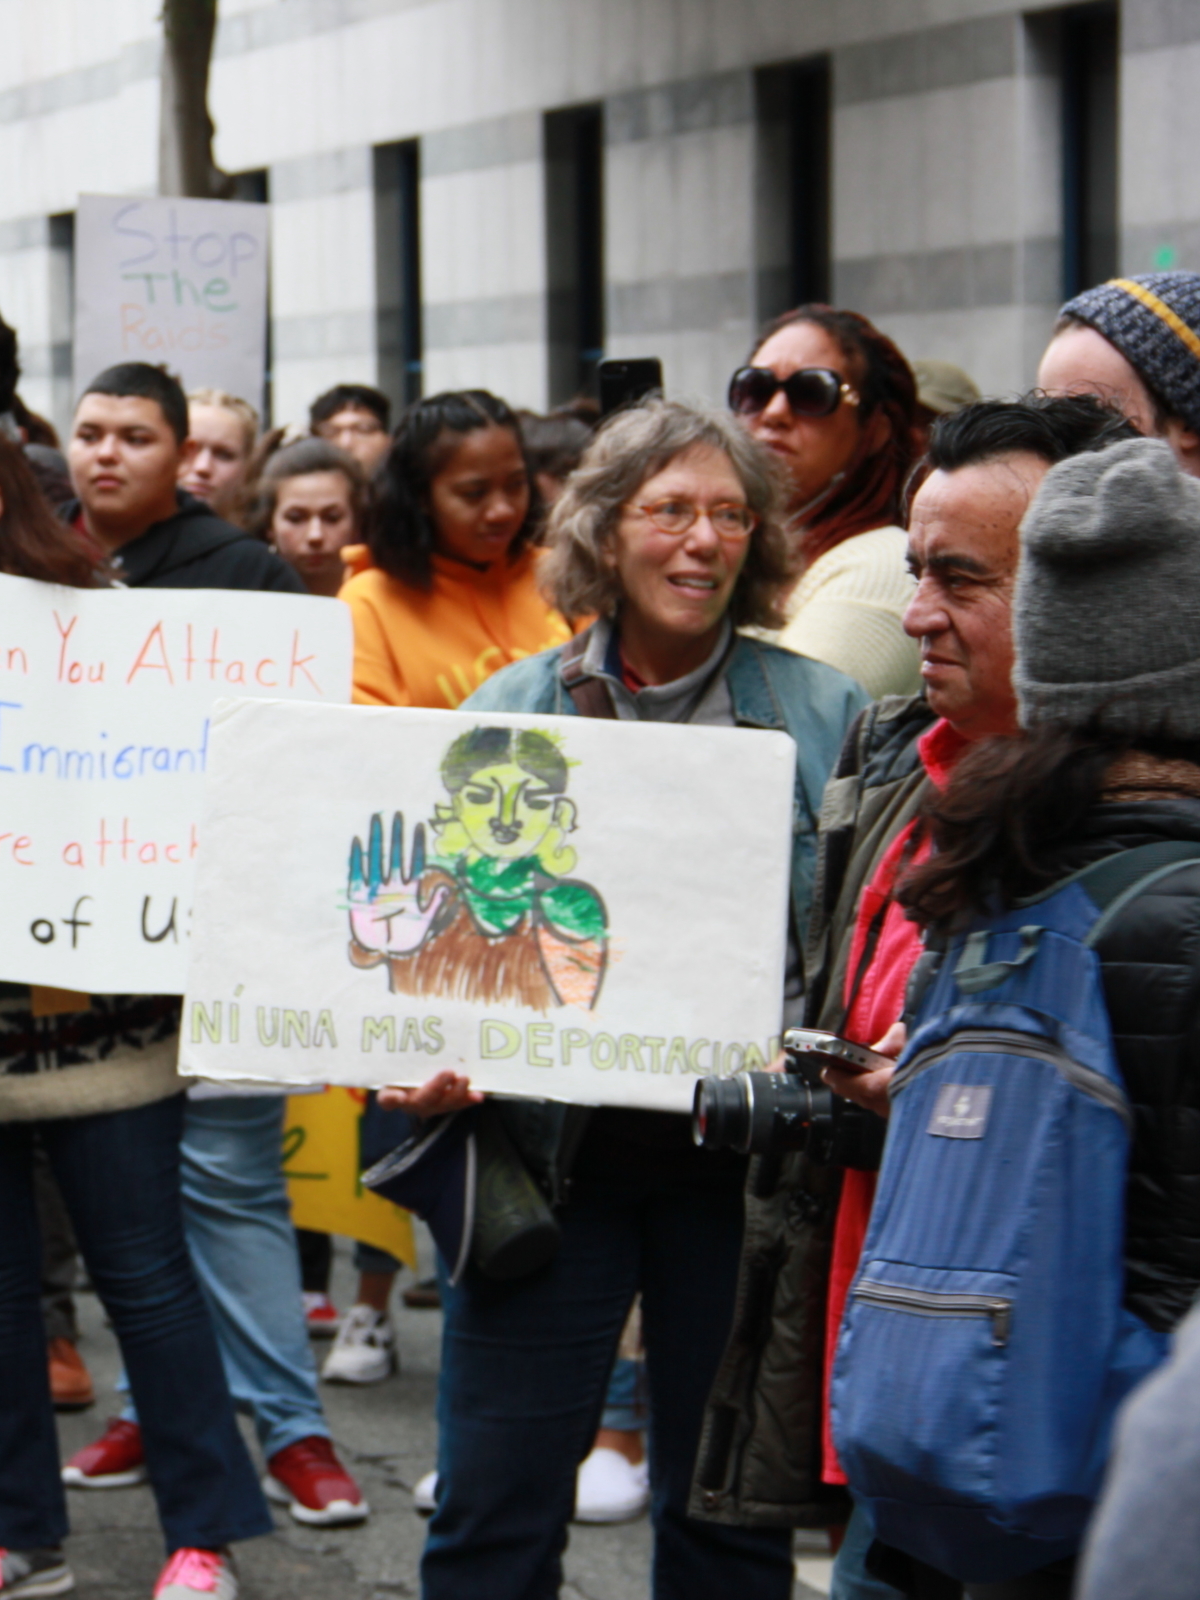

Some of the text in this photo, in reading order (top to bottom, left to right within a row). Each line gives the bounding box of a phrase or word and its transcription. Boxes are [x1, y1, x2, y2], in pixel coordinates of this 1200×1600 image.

[111, 202, 260, 278] Stop
[121, 269, 238, 313] The
[52, 609, 104, 684] You
[126, 619, 325, 696] Attack
[29, 893, 93, 950] of
[141, 894, 193, 945] U
[256, 1006, 339, 1049] UNA
[361, 1015, 446, 1056] MAS
